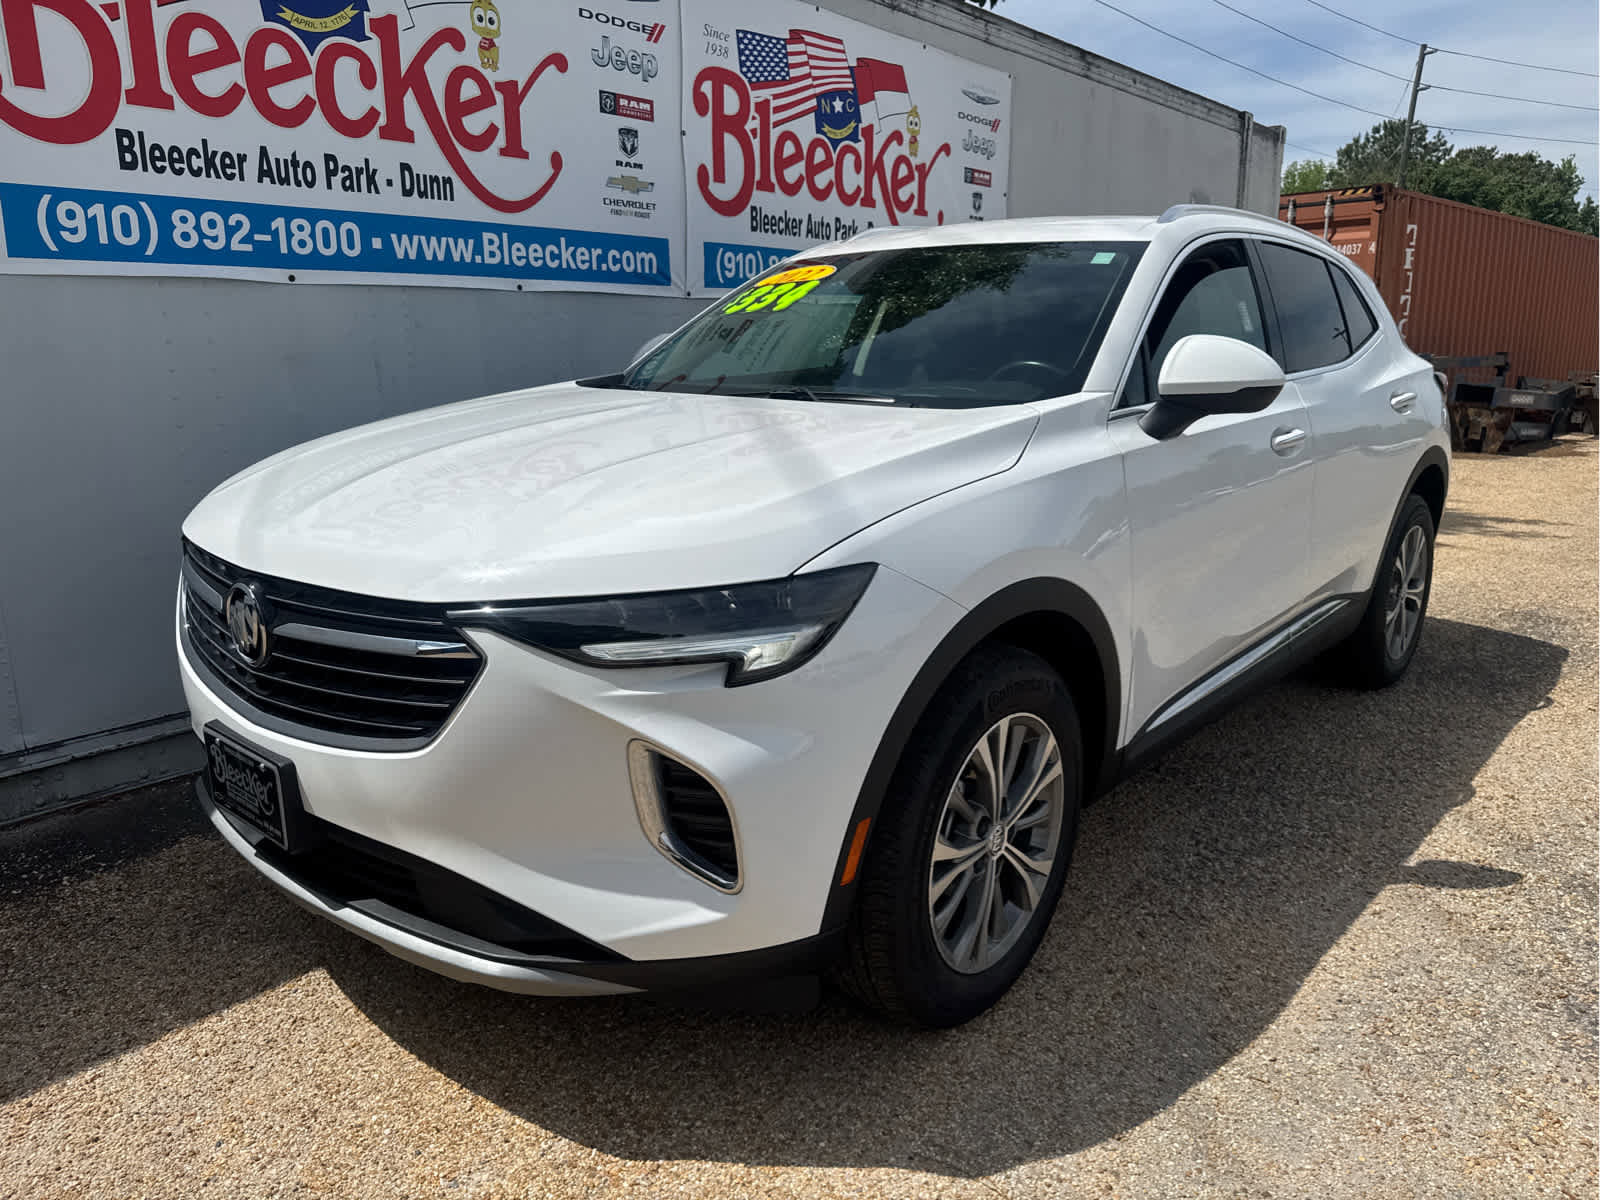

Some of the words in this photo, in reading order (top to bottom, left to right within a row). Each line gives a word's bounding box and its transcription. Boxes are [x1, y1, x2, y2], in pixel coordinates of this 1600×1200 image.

[293, 16, 318, 29] APRIL
[579, 7, 655, 35] DODGE
[703, 24, 730, 43] Since
[591, 35, 658, 82] Jeep
[705, 41, 729, 59] 1938
[619, 98, 651, 111] RAM
[821, 98, 831, 114] N
[958, 111, 993, 127] DODGE
[693, 66, 951, 225] Bleecker
[962, 129, 996, 160] Jeep
[115, 128, 247, 181] Bleecker
[257, 145, 317, 189] Auto
[323, 152, 380, 194] Park
[400, 162, 454, 201] Dunn
[616, 160, 643, 170] RAM
[603, 197, 656, 211] CHEVROLET
[37, 194, 158, 255] (910)
[171, 208, 361, 257] 892-1800
[390, 231, 657, 275] www.Bleecker.com
[750, 205, 803, 237] Bleecker
[806, 213, 831, 241] Auto
[834, 216, 858, 241] Park
[716, 247, 764, 284] (910)
